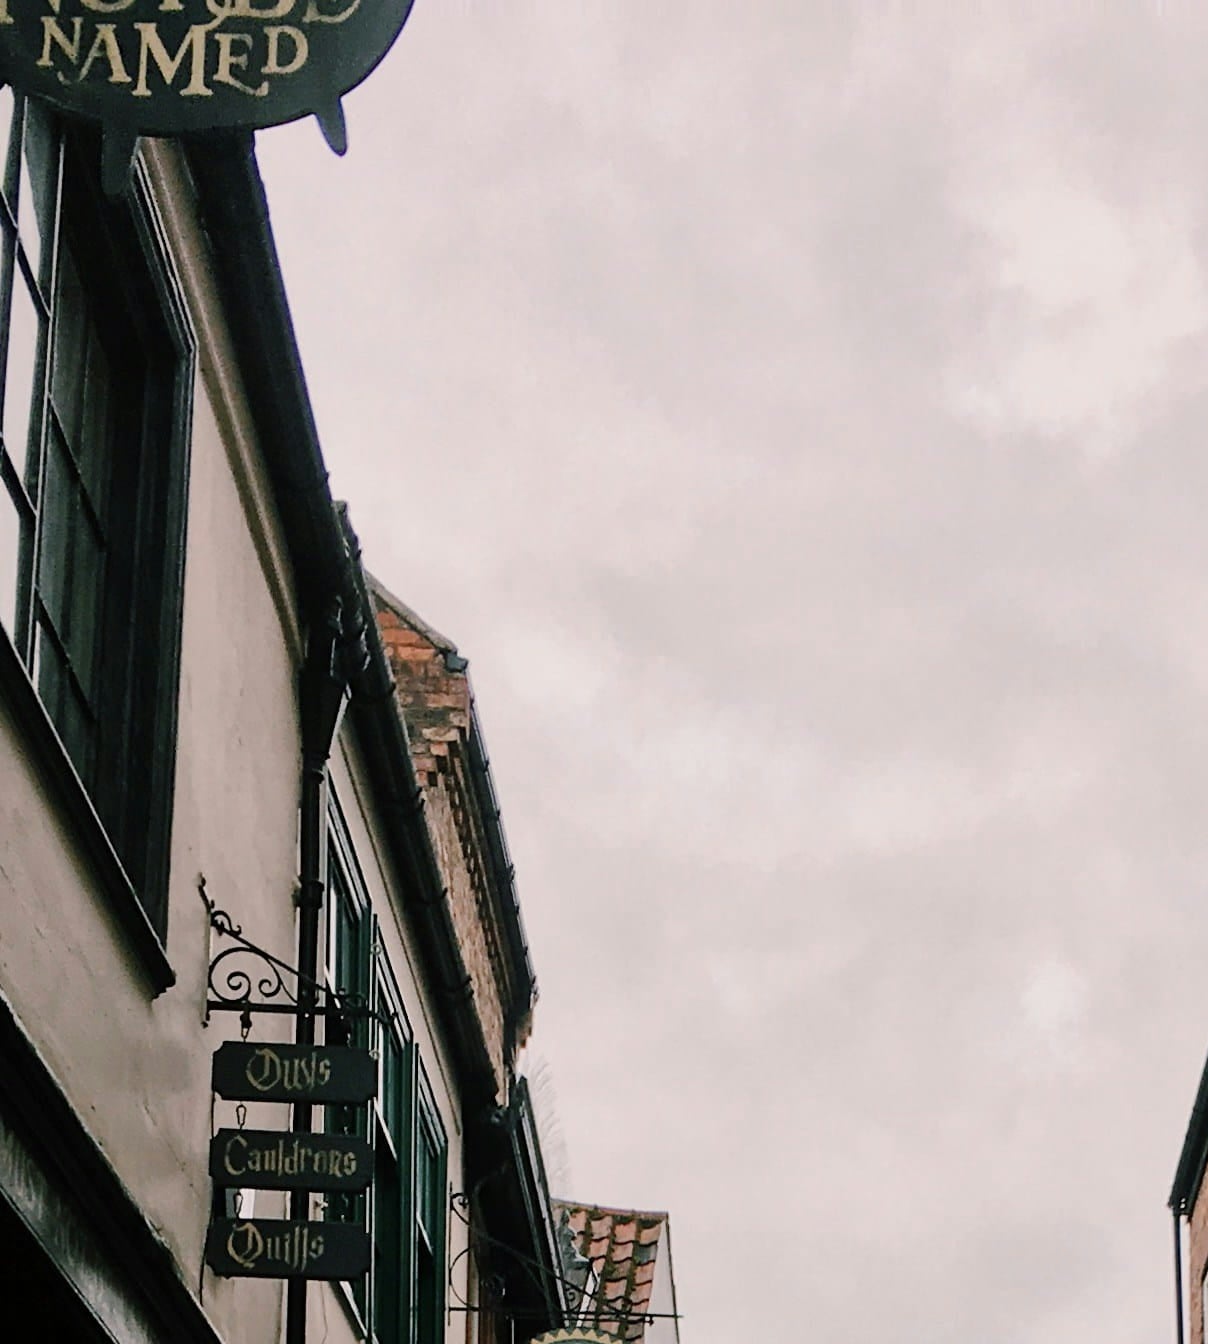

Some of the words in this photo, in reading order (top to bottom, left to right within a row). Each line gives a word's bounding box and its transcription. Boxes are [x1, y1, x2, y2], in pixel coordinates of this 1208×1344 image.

[36, 15, 309, 97] NAMED
[224, 1134, 357, 1178] Cauldrons
[226, 1221, 325, 1273] Quills
